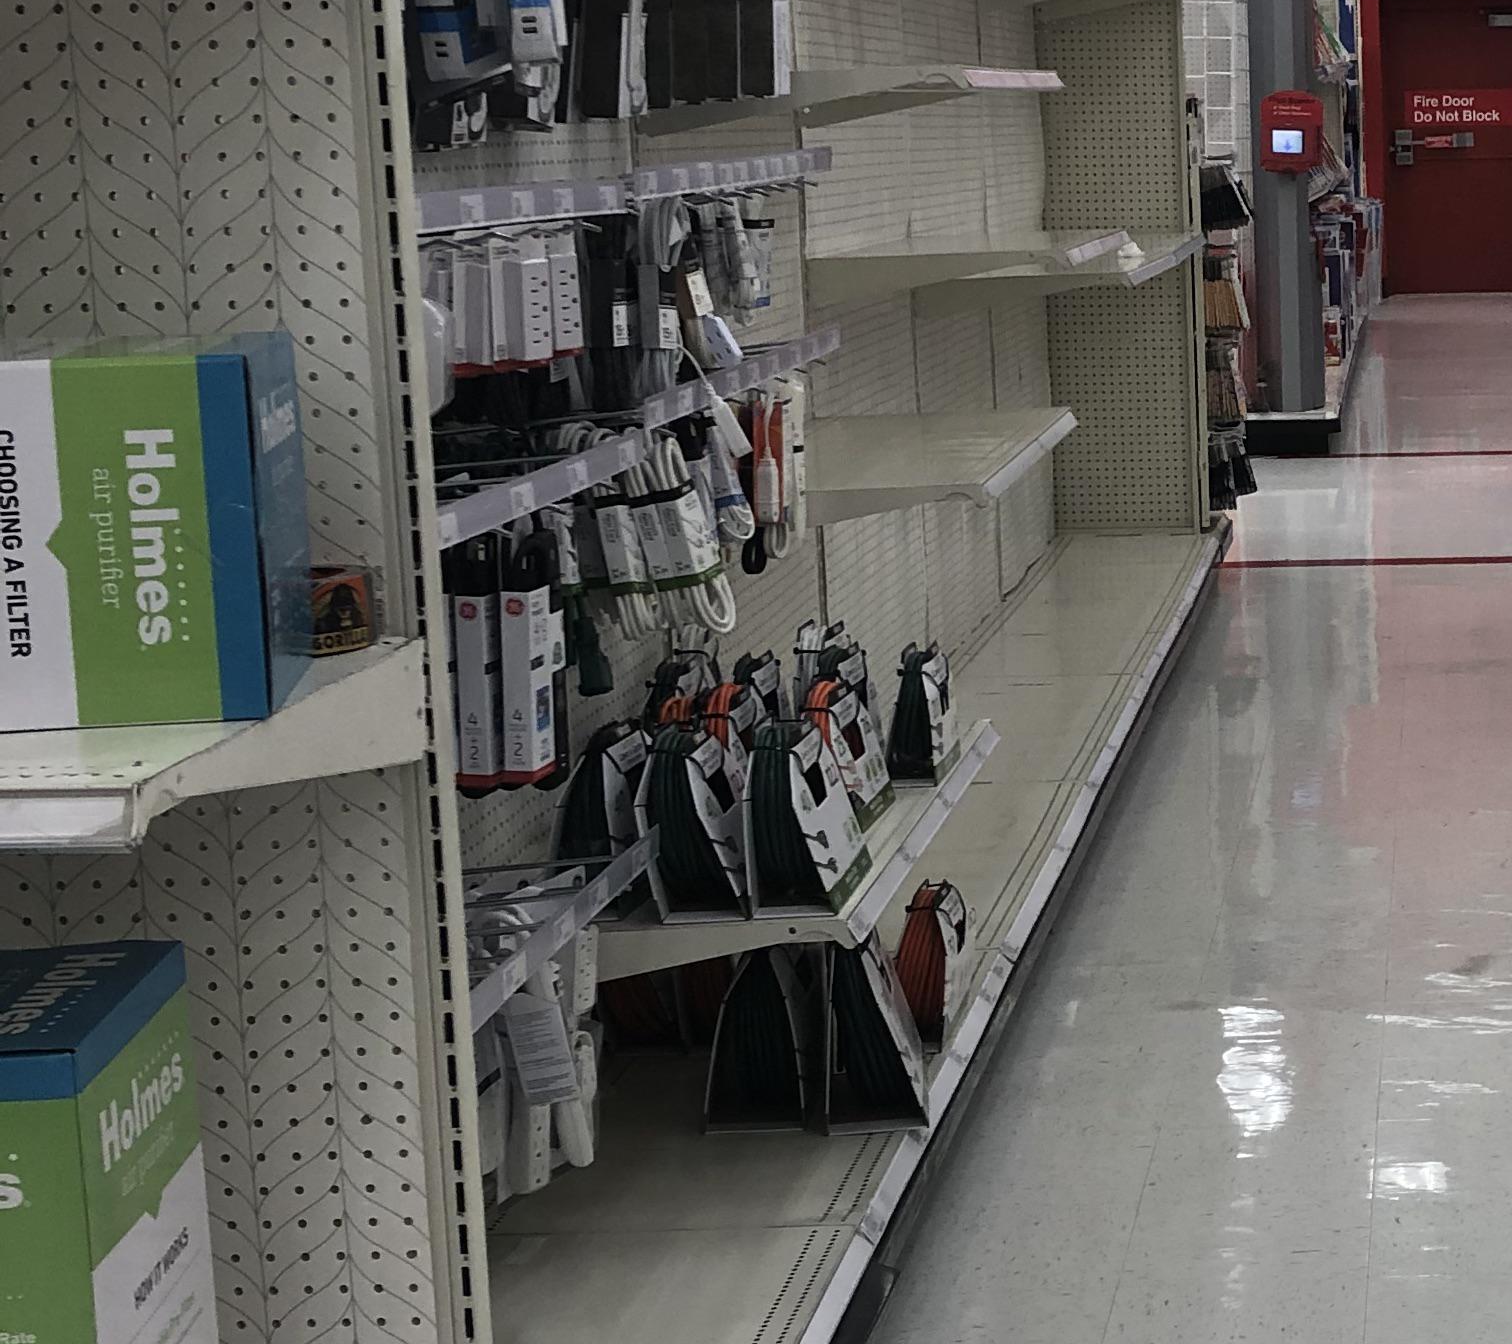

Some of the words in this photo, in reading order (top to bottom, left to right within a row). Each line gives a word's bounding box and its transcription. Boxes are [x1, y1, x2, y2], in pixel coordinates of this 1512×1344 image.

[1413, 94, 1439, 107] Fire
[1442, 94, 1475, 107] Door
[1414, 110, 1433, 123] Do
[1436, 110, 1459, 123] Not
[1462, 109, 1500, 122] Block
[0, 429, 23, 551] CHOOSING
[92, 466, 117, 505] air
[3, 556, 25, 574] A
[88, 510, 124, 610] purifier
[123, 428, 180, 646] Holmes
[5, 580, 32, 658] FILTER
[0, 952, 127, 1036] Holmes
[99, 1052, 184, 1173] Holmes
